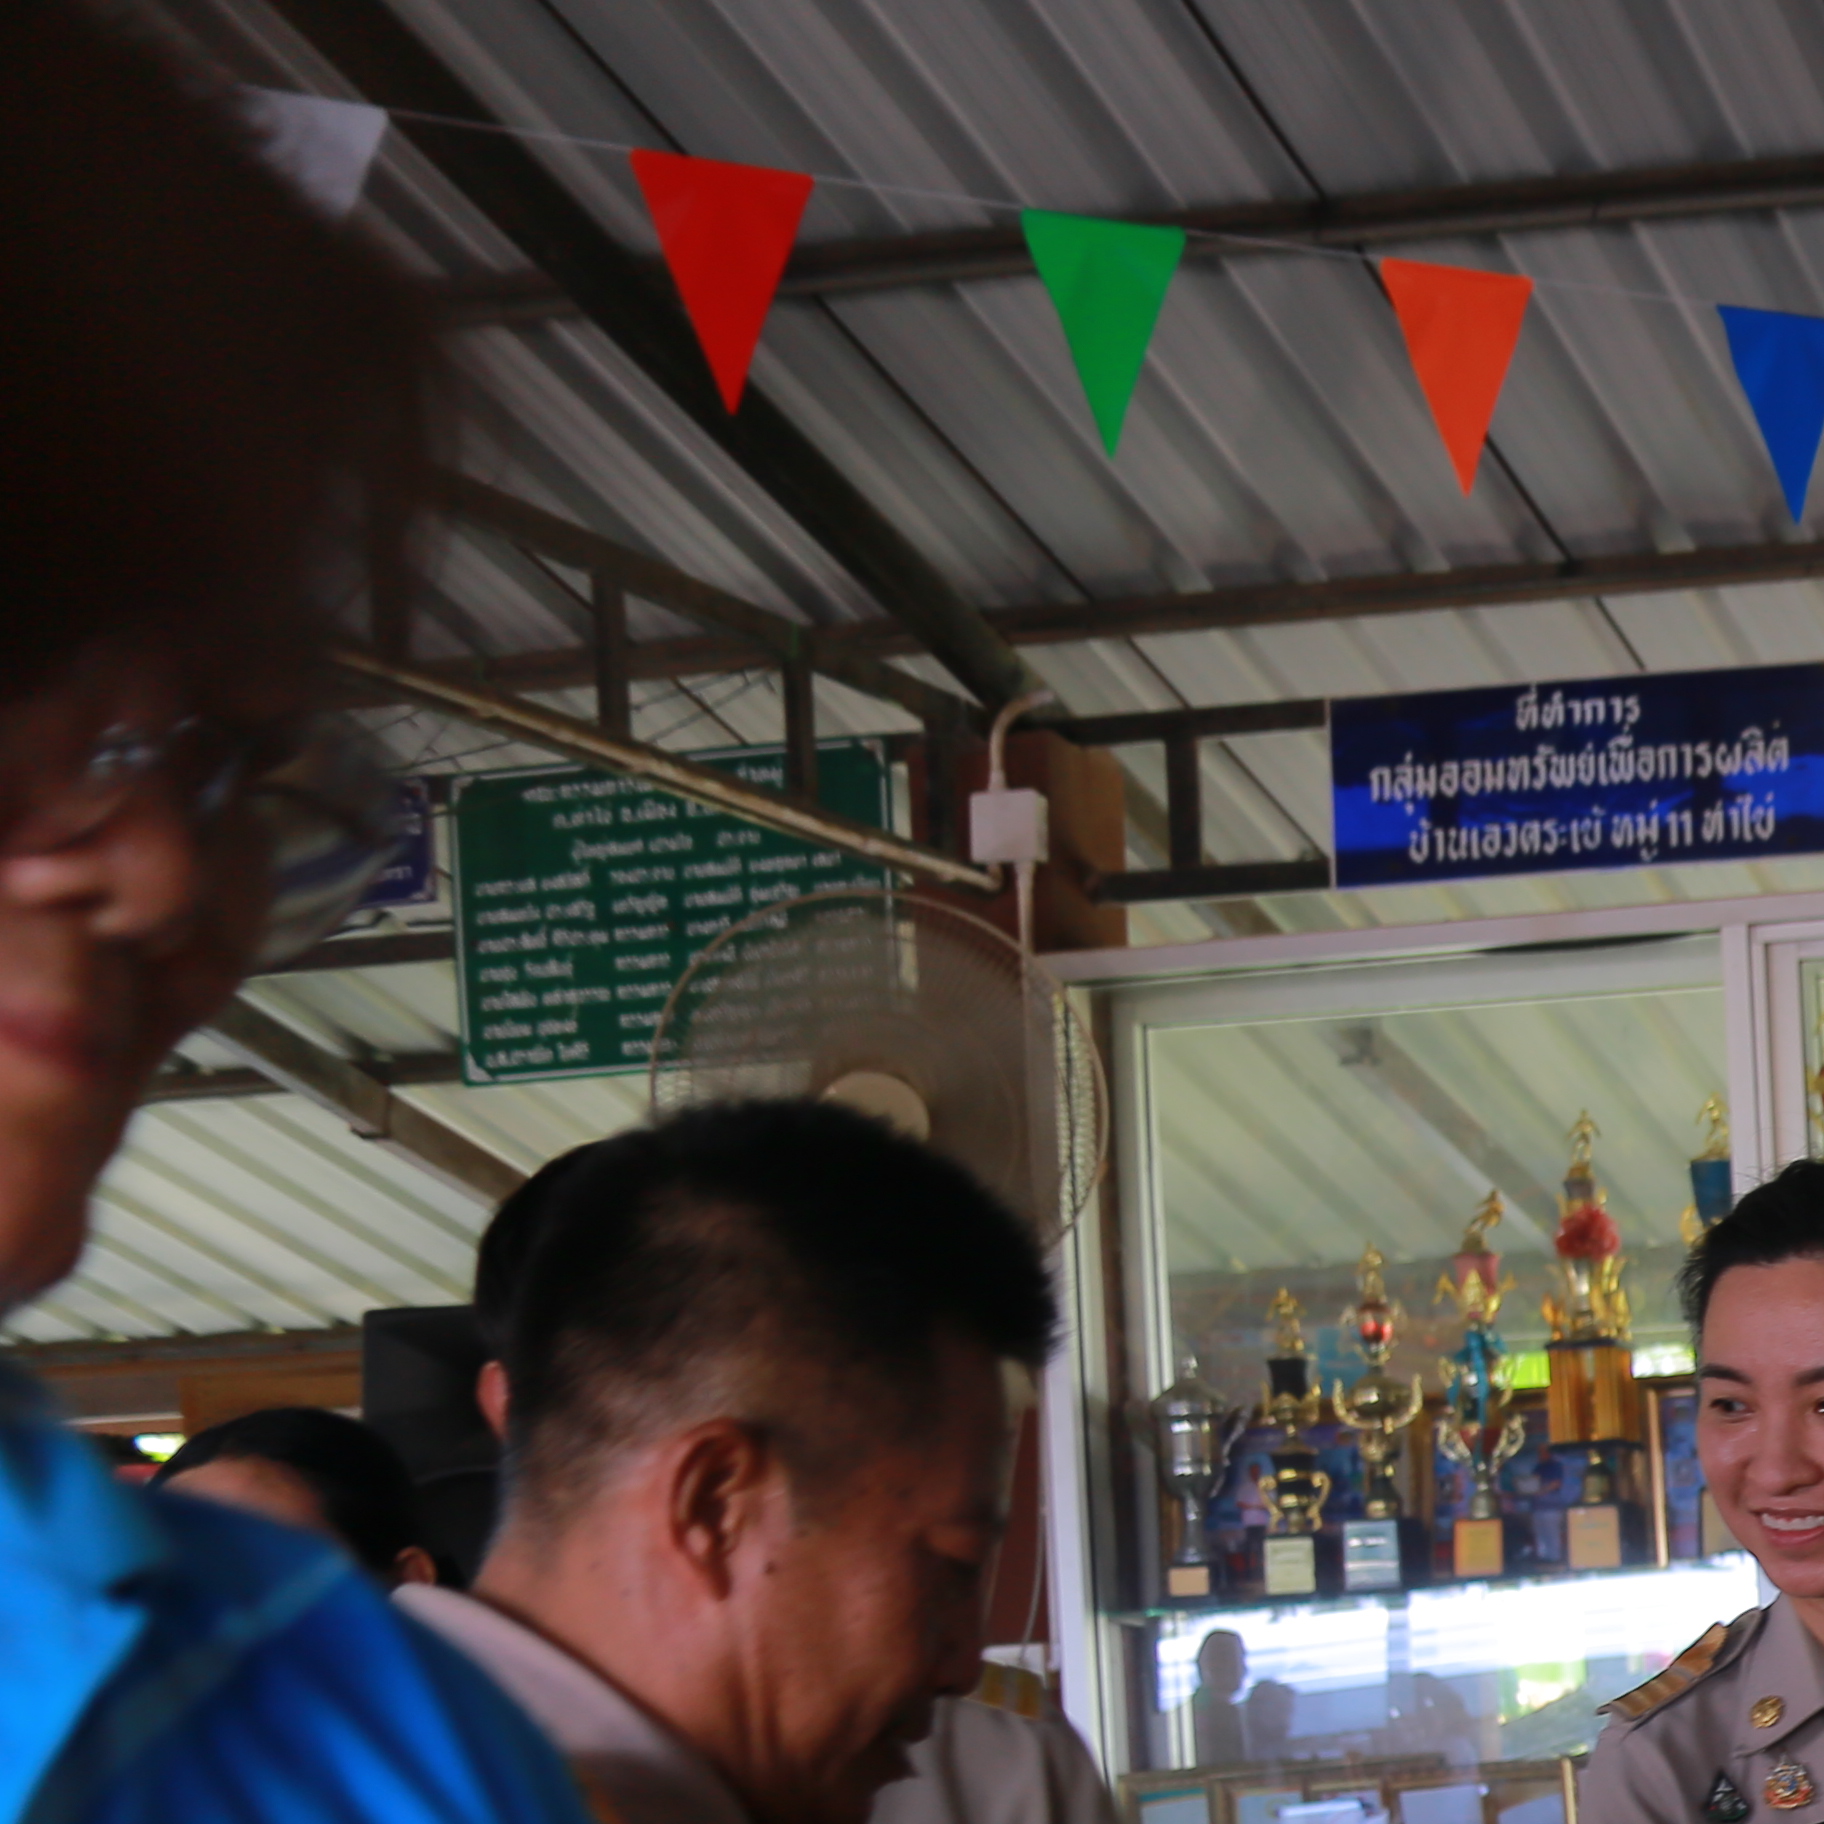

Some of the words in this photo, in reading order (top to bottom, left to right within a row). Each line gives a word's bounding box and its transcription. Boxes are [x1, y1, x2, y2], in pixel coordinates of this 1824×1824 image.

[1515, 684, 1642, 732] ที่ทำการ
[1368, 727, 1791, 817] กลุ่มออมทรัพย์เพื่อการผลิต
[1612, 800, 1660, 864] หมู่
[1667, 806, 1693, 848] 11
[1701, 791, 1777, 842] ท่าไข่
